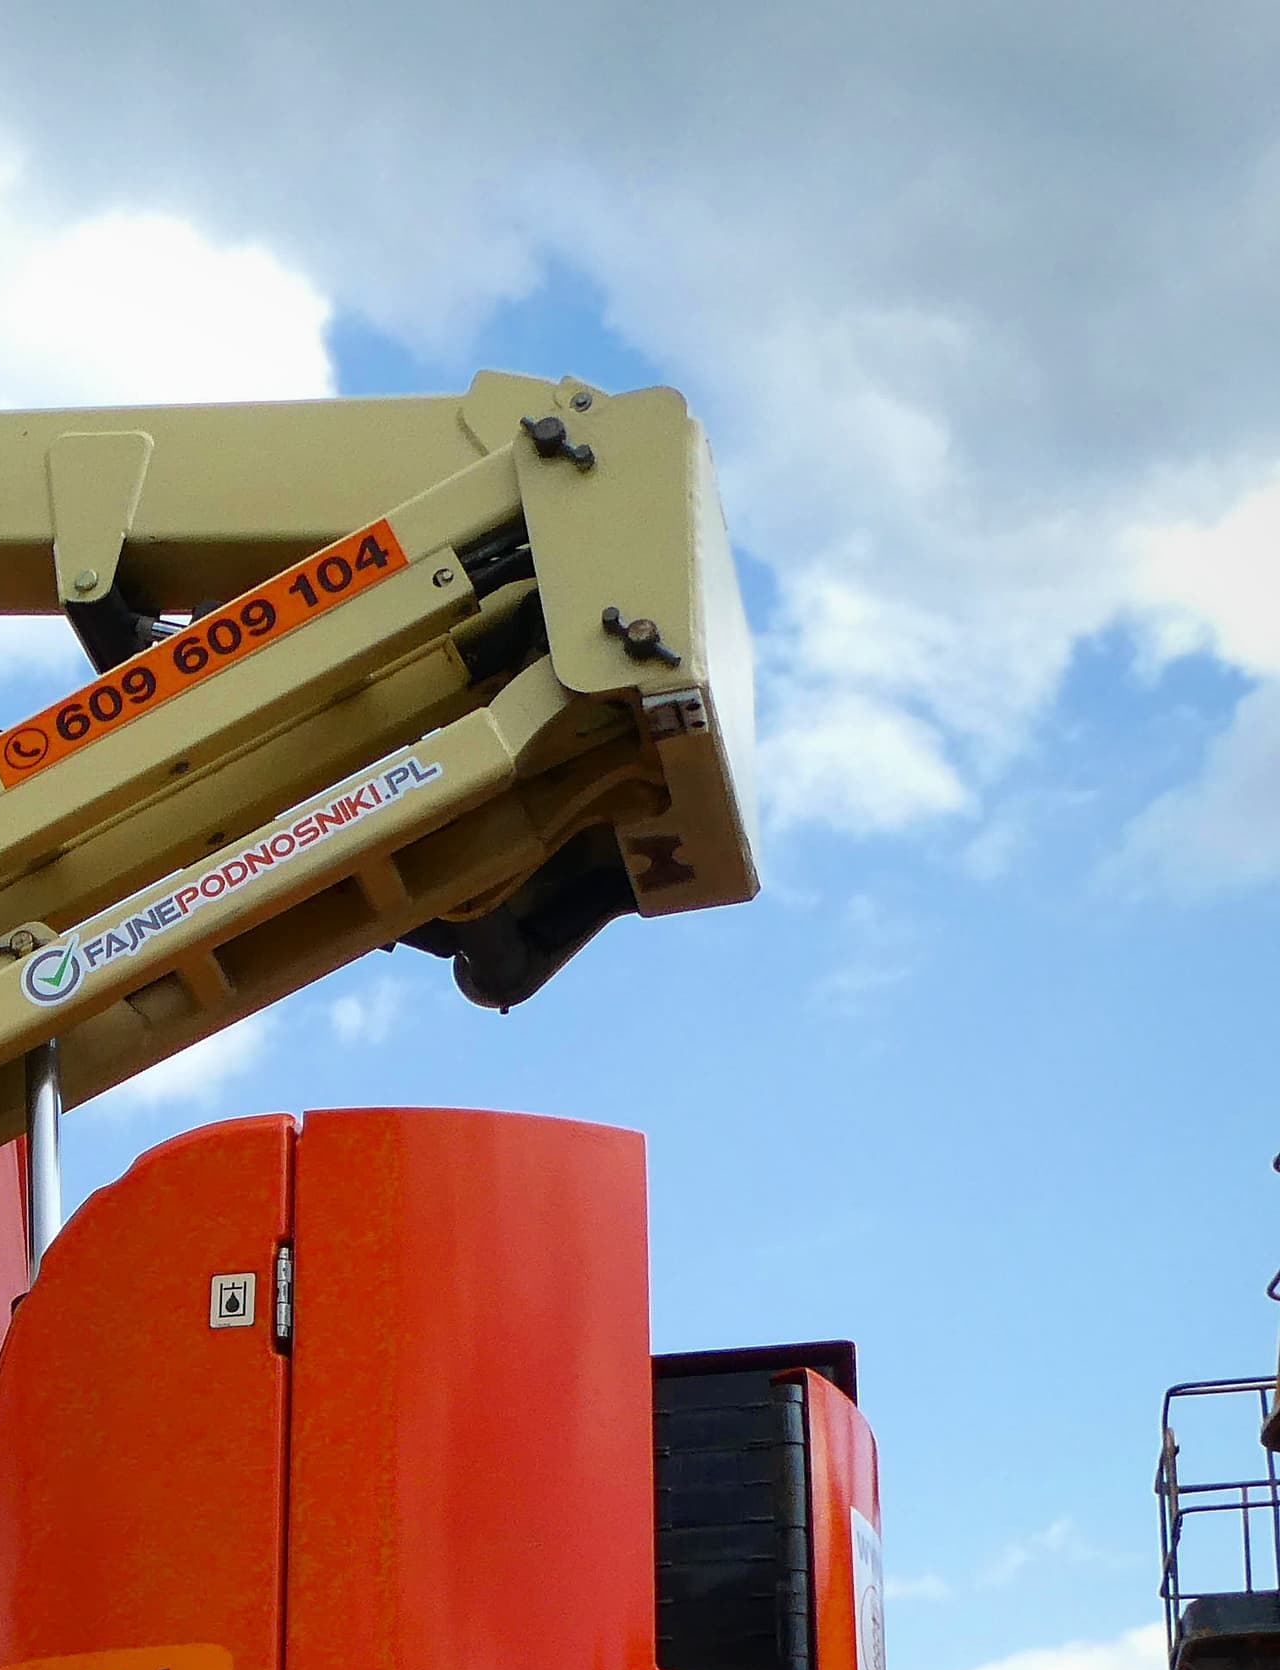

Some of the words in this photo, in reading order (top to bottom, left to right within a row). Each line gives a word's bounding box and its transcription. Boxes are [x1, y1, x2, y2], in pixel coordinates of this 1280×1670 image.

[56, 665, 157, 742] 609
[173, 598, 277, 675] 609
[288, 533, 390, 608] 104
[83, 756, 439, 969] FAJNEPODNOSNIKI.PL
